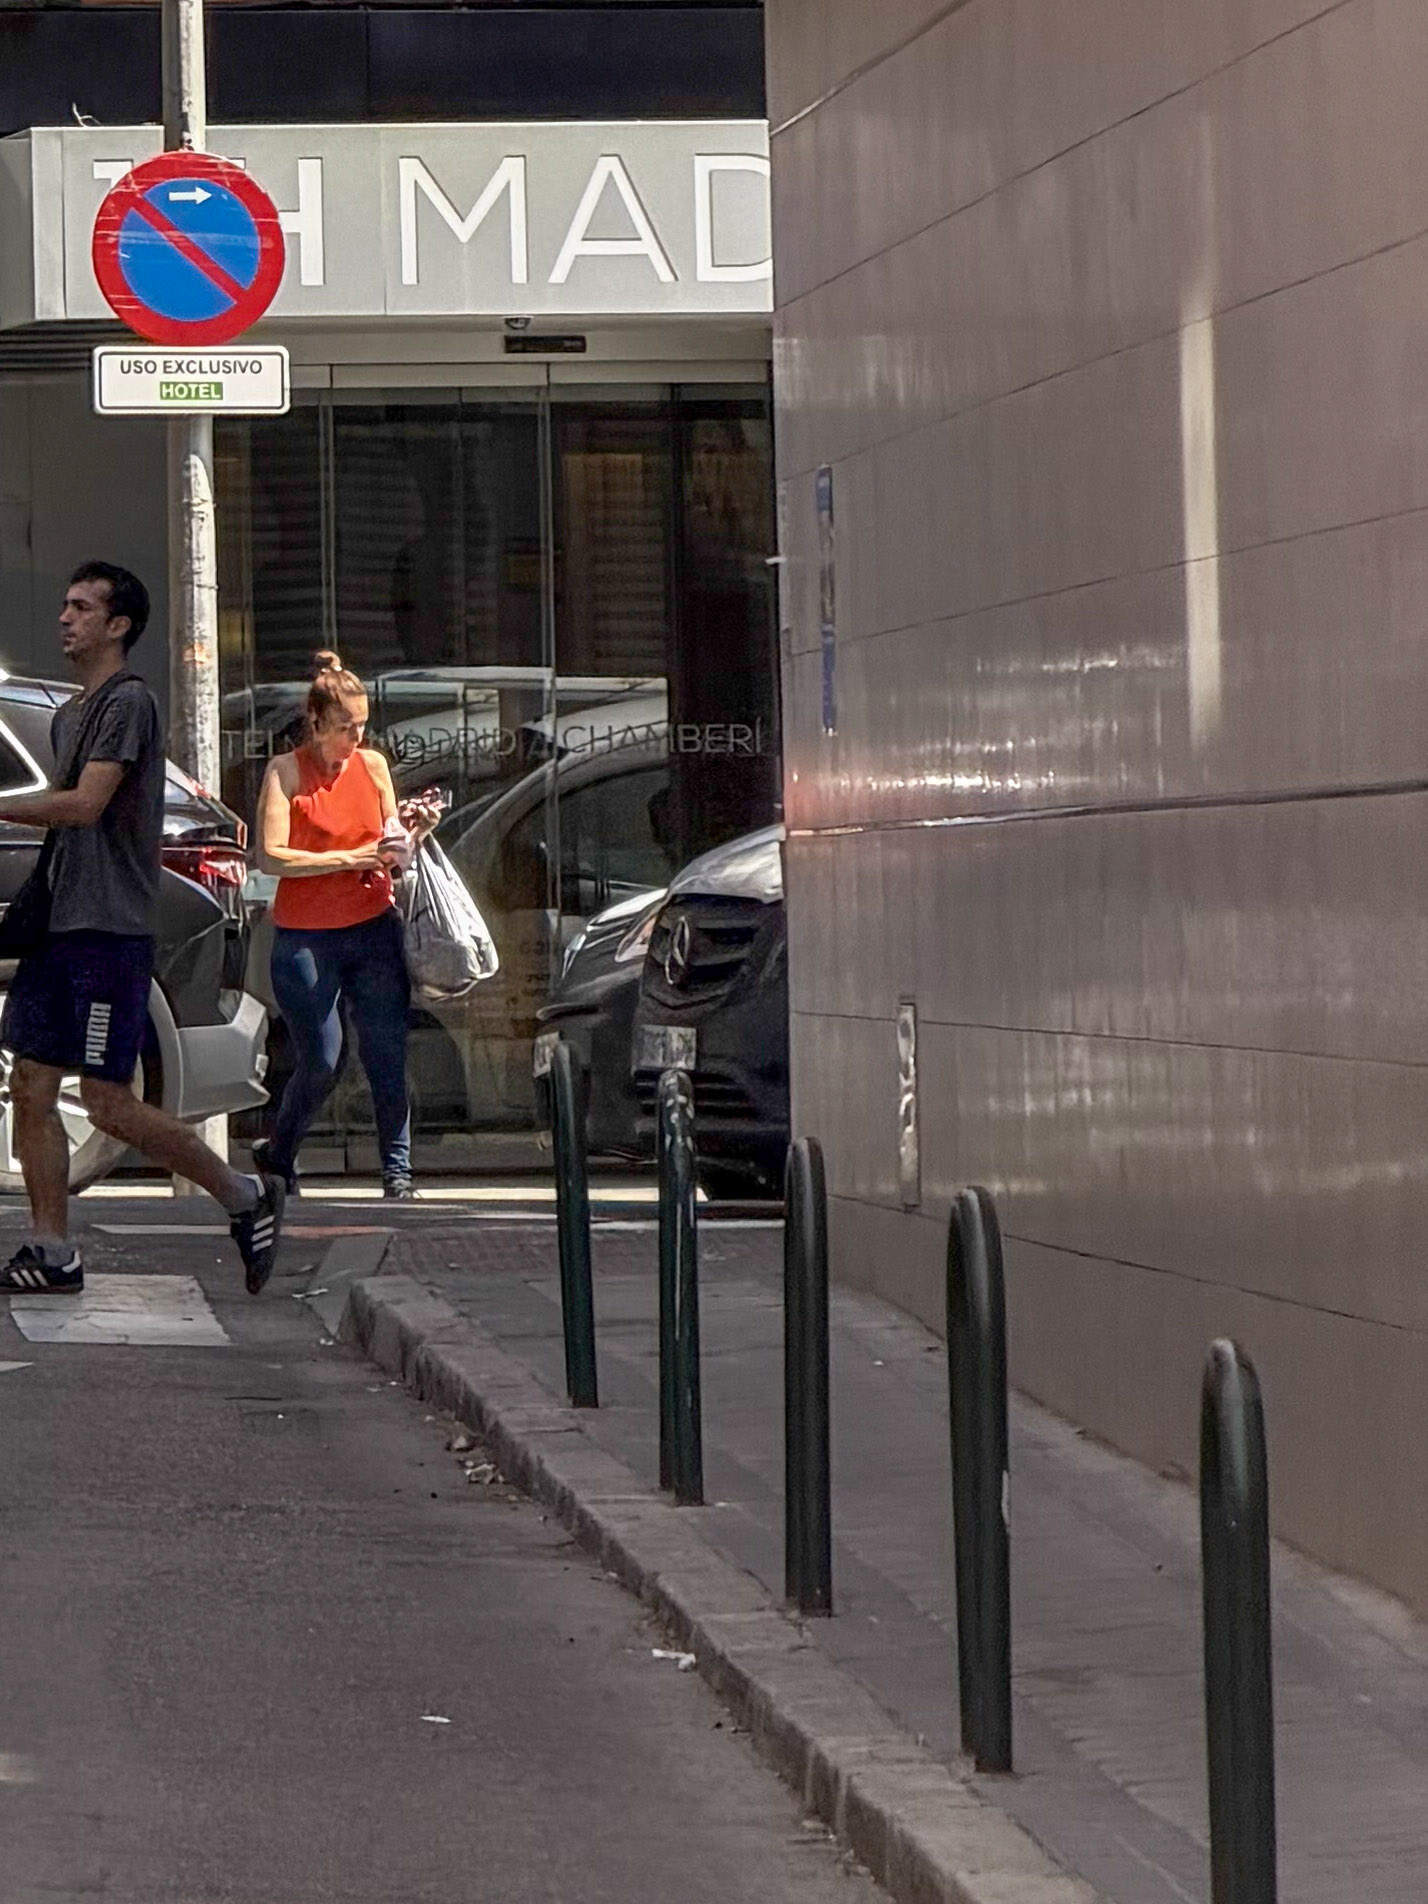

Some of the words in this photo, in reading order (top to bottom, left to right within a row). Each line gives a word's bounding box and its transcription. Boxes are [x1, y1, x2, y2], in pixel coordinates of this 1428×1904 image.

[120, 359, 158, 376] USO
[162, 359, 263, 376] EXCLUSIVO
[160, 382, 222, 400] HOTEL
